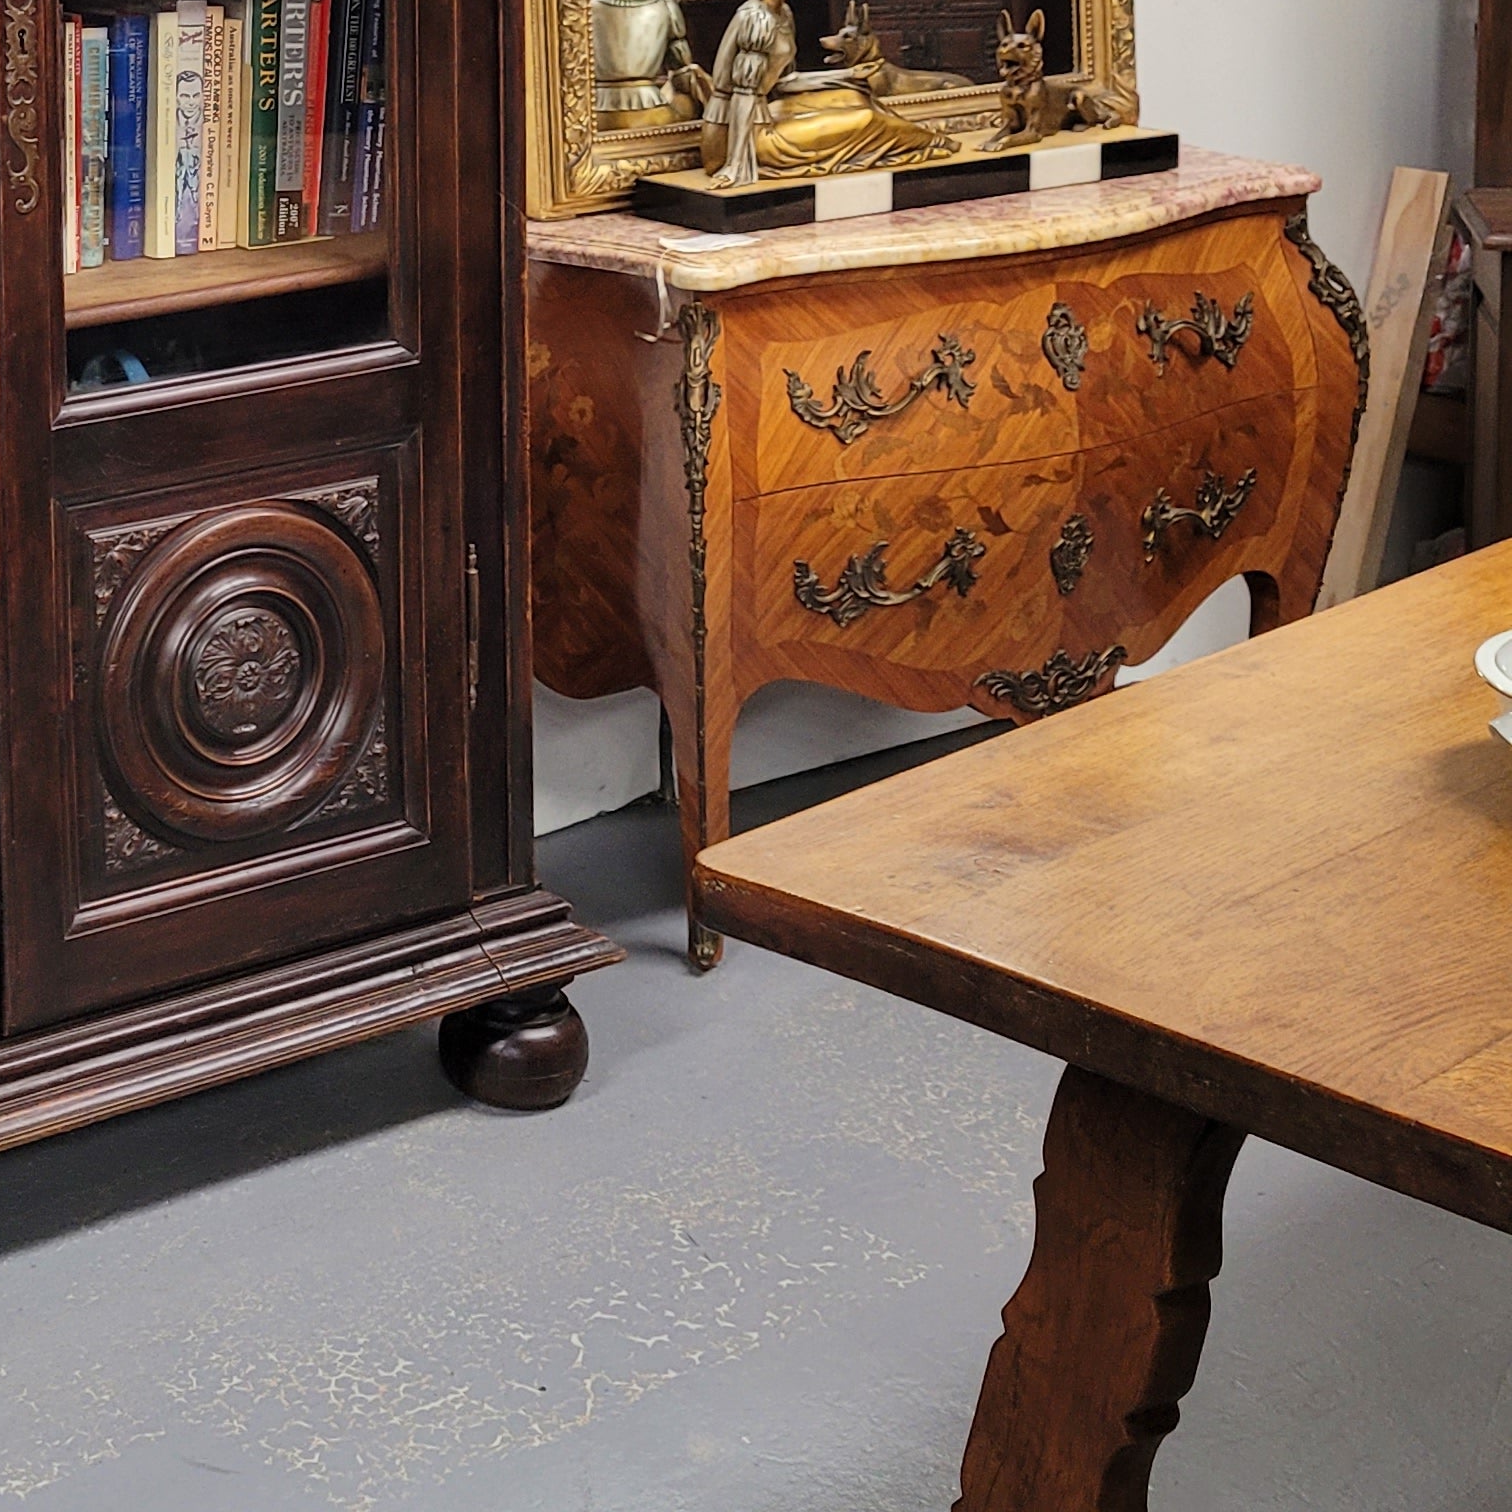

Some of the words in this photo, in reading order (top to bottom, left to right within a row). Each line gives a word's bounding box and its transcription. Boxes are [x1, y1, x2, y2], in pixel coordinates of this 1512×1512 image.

[204, 14, 213, 53] TOWNS
[214, 26, 222, 46] OLD
[349, 14, 359, 36] THE
[372, 12, 380, 46] Features
[128, 38, 136, 50] OF
[228, 26, 238, 73] Australia:
[349, 37, 358, 51] 100
[372, 50, 378, 58] of
[135, 40, 144, 94] AUSTRALIAN
[204, 55, 212, 67] OF
[213, 48, 222, 77] GOLD
[128, 52, 136, 104] BIOGRAPHY
[227, 74, 234, 86] as
[345, 52, 357, 103] GREATEST
[203, 68, 212, 123] AUSTRALIA
[134, 96, 143, 150] DICTIONARY
[227, 112, 233, 125] we
[364, 126, 373, 151] Snowy
[375, 122, 385, 148] Snowy
[205, 136, 216, 178] Darbyshire
[258, 144, 267, 166] 2001
[363, 154, 371, 193] Mountains
[373, 150, 383, 190] Mountains
[206, 183, 214, 192] C.
[257, 167, 266, 209] Federation
[203, 201, 214, 229] Sayers
[277, 197, 289, 235] Edition
[288, 203, 299, 228] 2007
[360, 195, 369, 226] Scheme
[371, 193, 379, 223] Scheme
[256, 211, 266, 239] Edition
